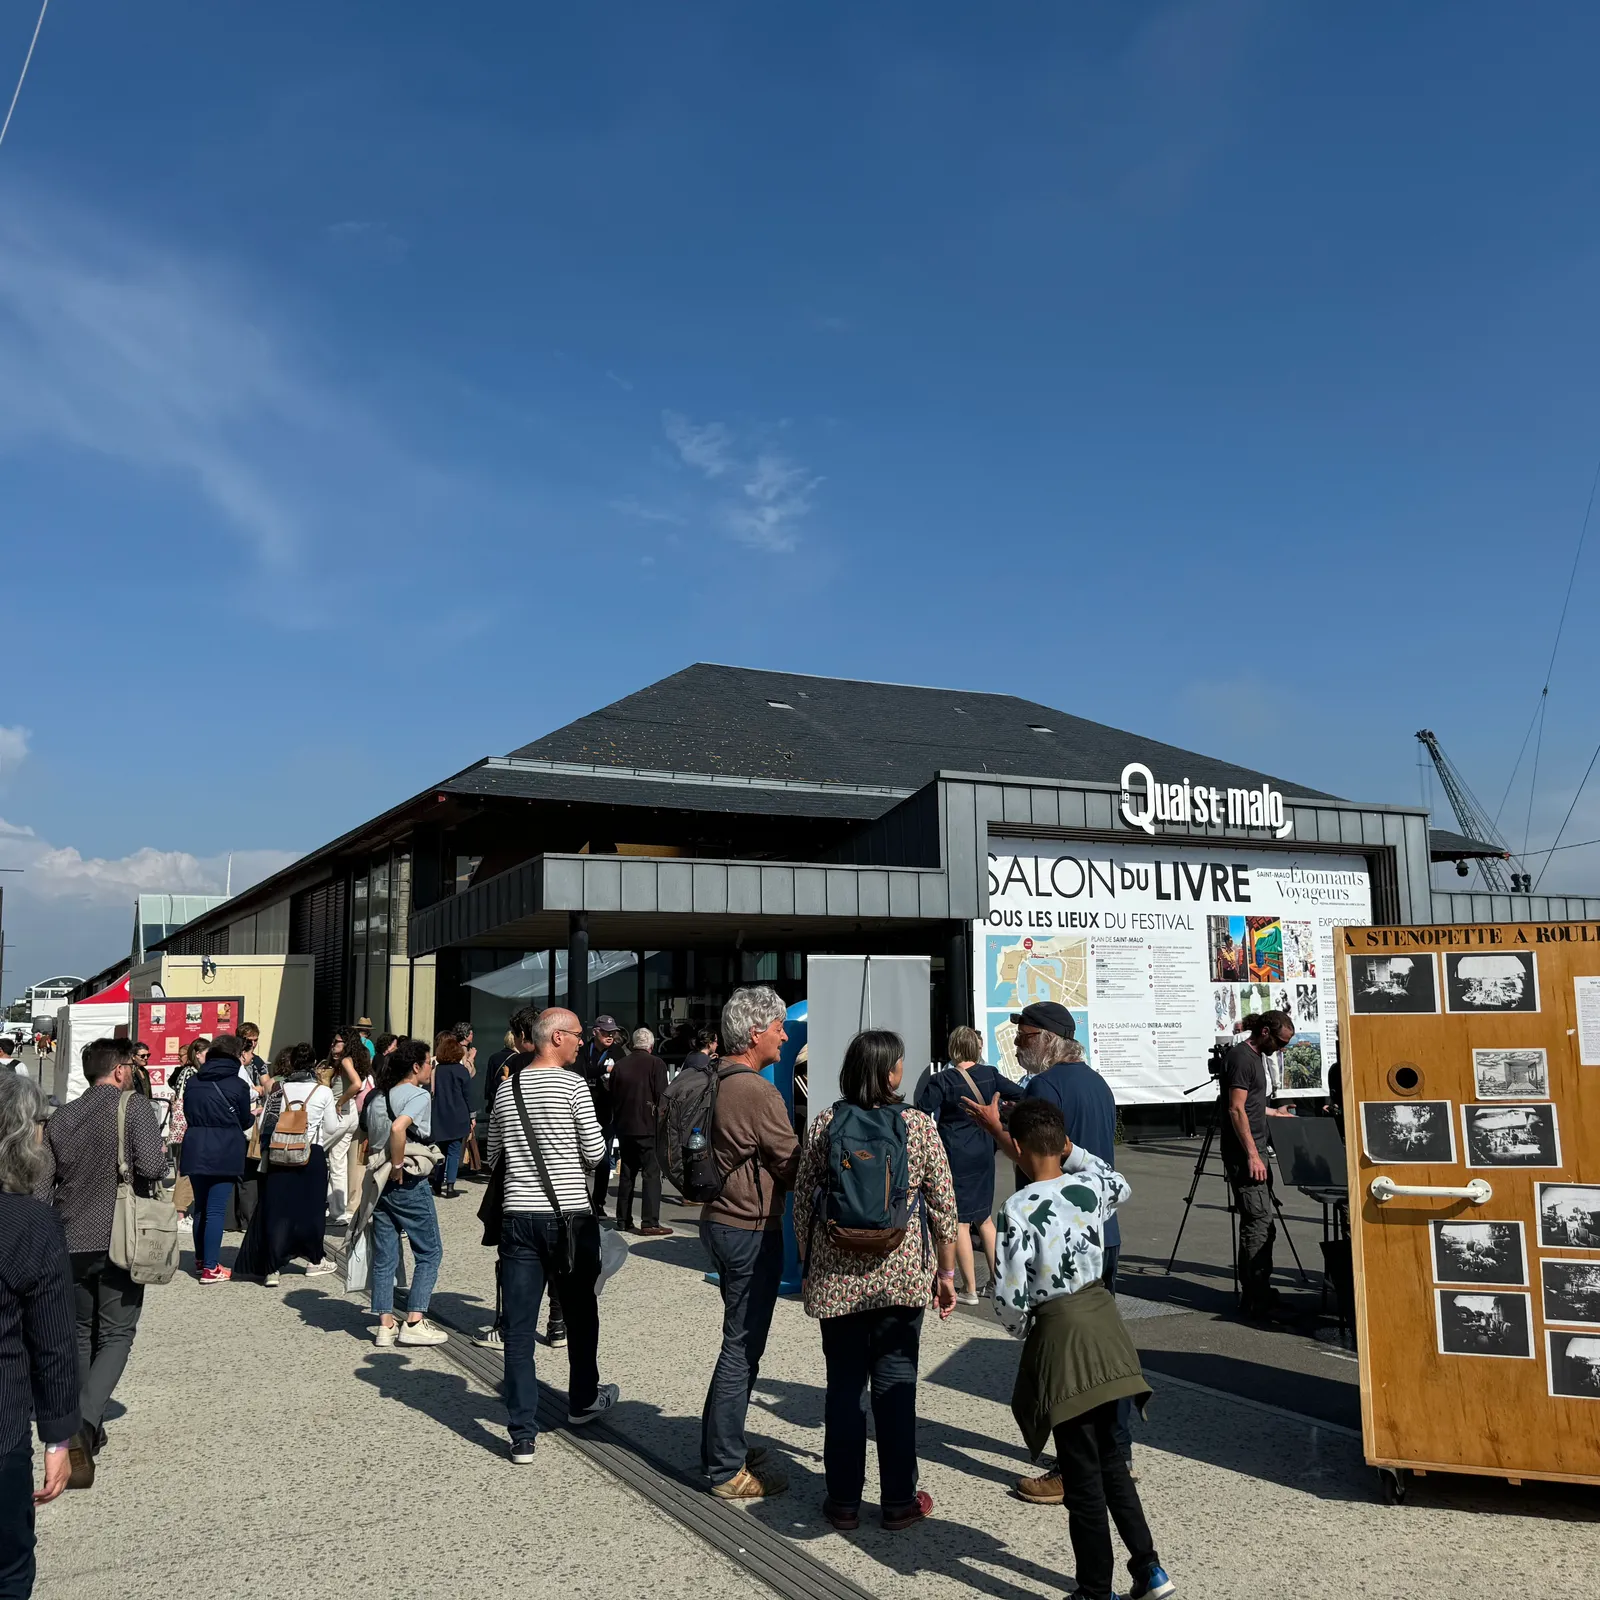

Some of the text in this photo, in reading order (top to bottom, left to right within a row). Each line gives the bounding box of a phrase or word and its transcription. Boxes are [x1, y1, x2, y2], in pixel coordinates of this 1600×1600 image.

[1121, 762, 1191, 835] Quai
[988, 852, 1252, 903] SALON DU LIVRE
[1256, 861, 1364, 886] SAINT-MALO Étonnants
[1276, 880, 1350, 905] Voyageurs
[1028, 910, 1053, 928] LES
[1057, 911, 1100, 929] LIEUX
[1104, 912, 1127, 930] DU
[1131, 913, 1194, 931] FESTIVAL
[1366, 928, 1503, 946] STENOPETTE
[1513, 928, 1529, 944] A
[1536, 925, 1600, 943] ROUL
